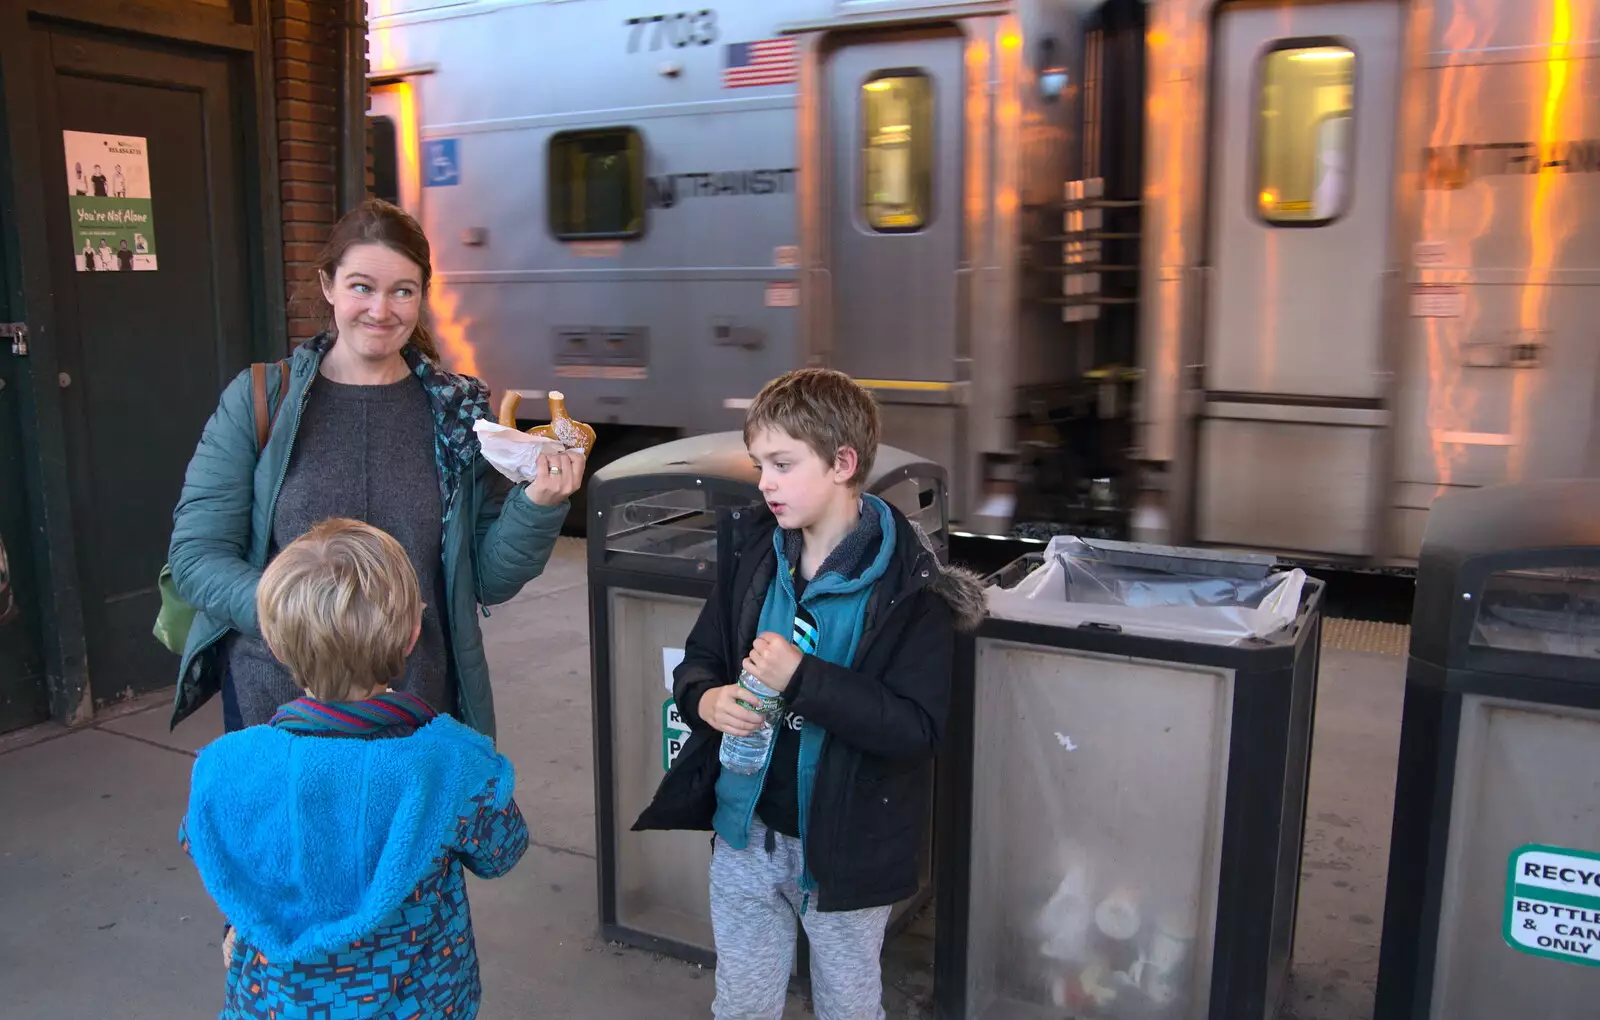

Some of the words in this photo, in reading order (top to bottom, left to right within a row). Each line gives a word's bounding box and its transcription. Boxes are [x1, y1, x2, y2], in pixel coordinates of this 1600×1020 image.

[624, 9, 721, 54] 7703
[77, 208, 106, 222] You're
[107, 209, 123, 223] Not
[124, 209, 148, 223] Alone
[1522, 918, 1537, 931] &
[1536, 936, 1593, 954] ONLY
